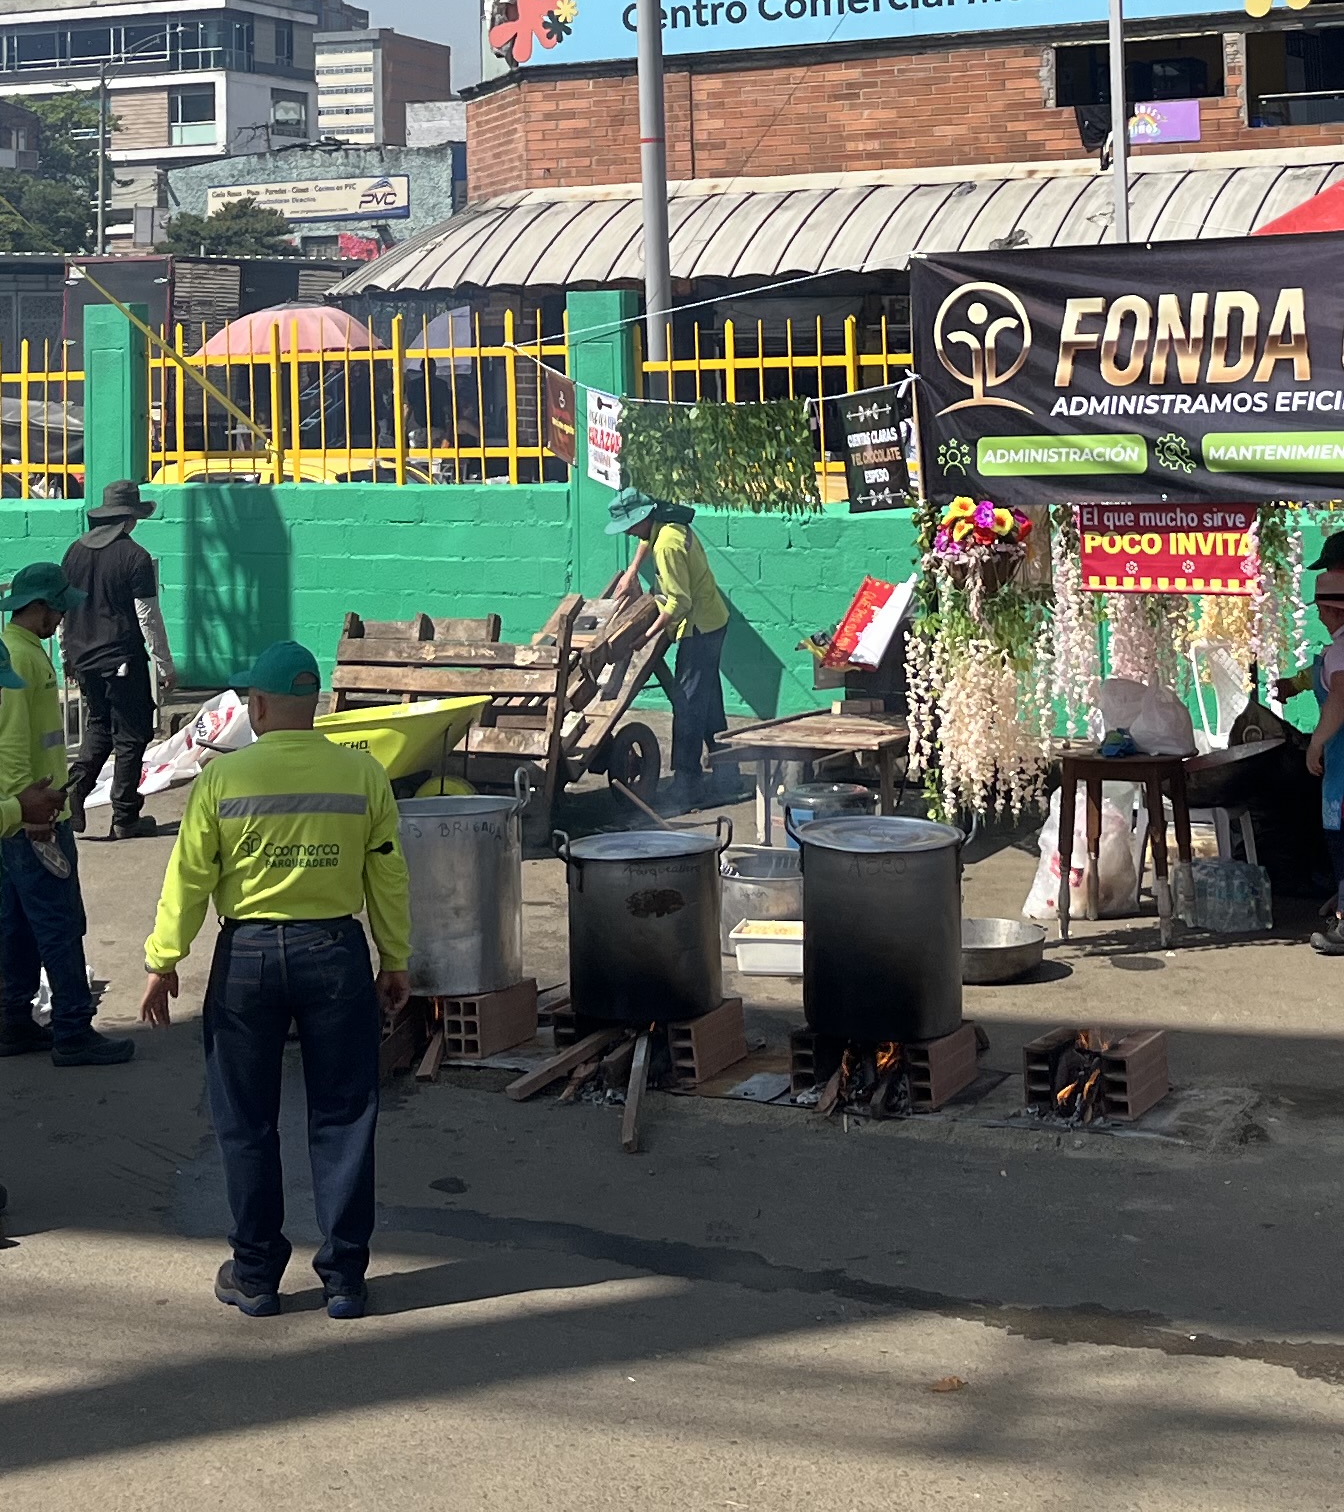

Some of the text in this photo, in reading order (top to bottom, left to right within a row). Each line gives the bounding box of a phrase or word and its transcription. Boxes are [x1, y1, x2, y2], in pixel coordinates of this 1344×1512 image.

[359, 192, 397, 209] PVC
[1054, 287, 1312, 387] FONDA
[1050, 391, 1269, 417] ADMINISTRAMOS
[982, 443, 1140, 464] ADMINISTRACIÓN
[1082, 506, 1247, 530] El que mucho sirve
[1084, 531, 1163, 555] POCO
[263, 841, 341, 858] Coomerca
[265, 857, 339, 869] PARQUEADERO
